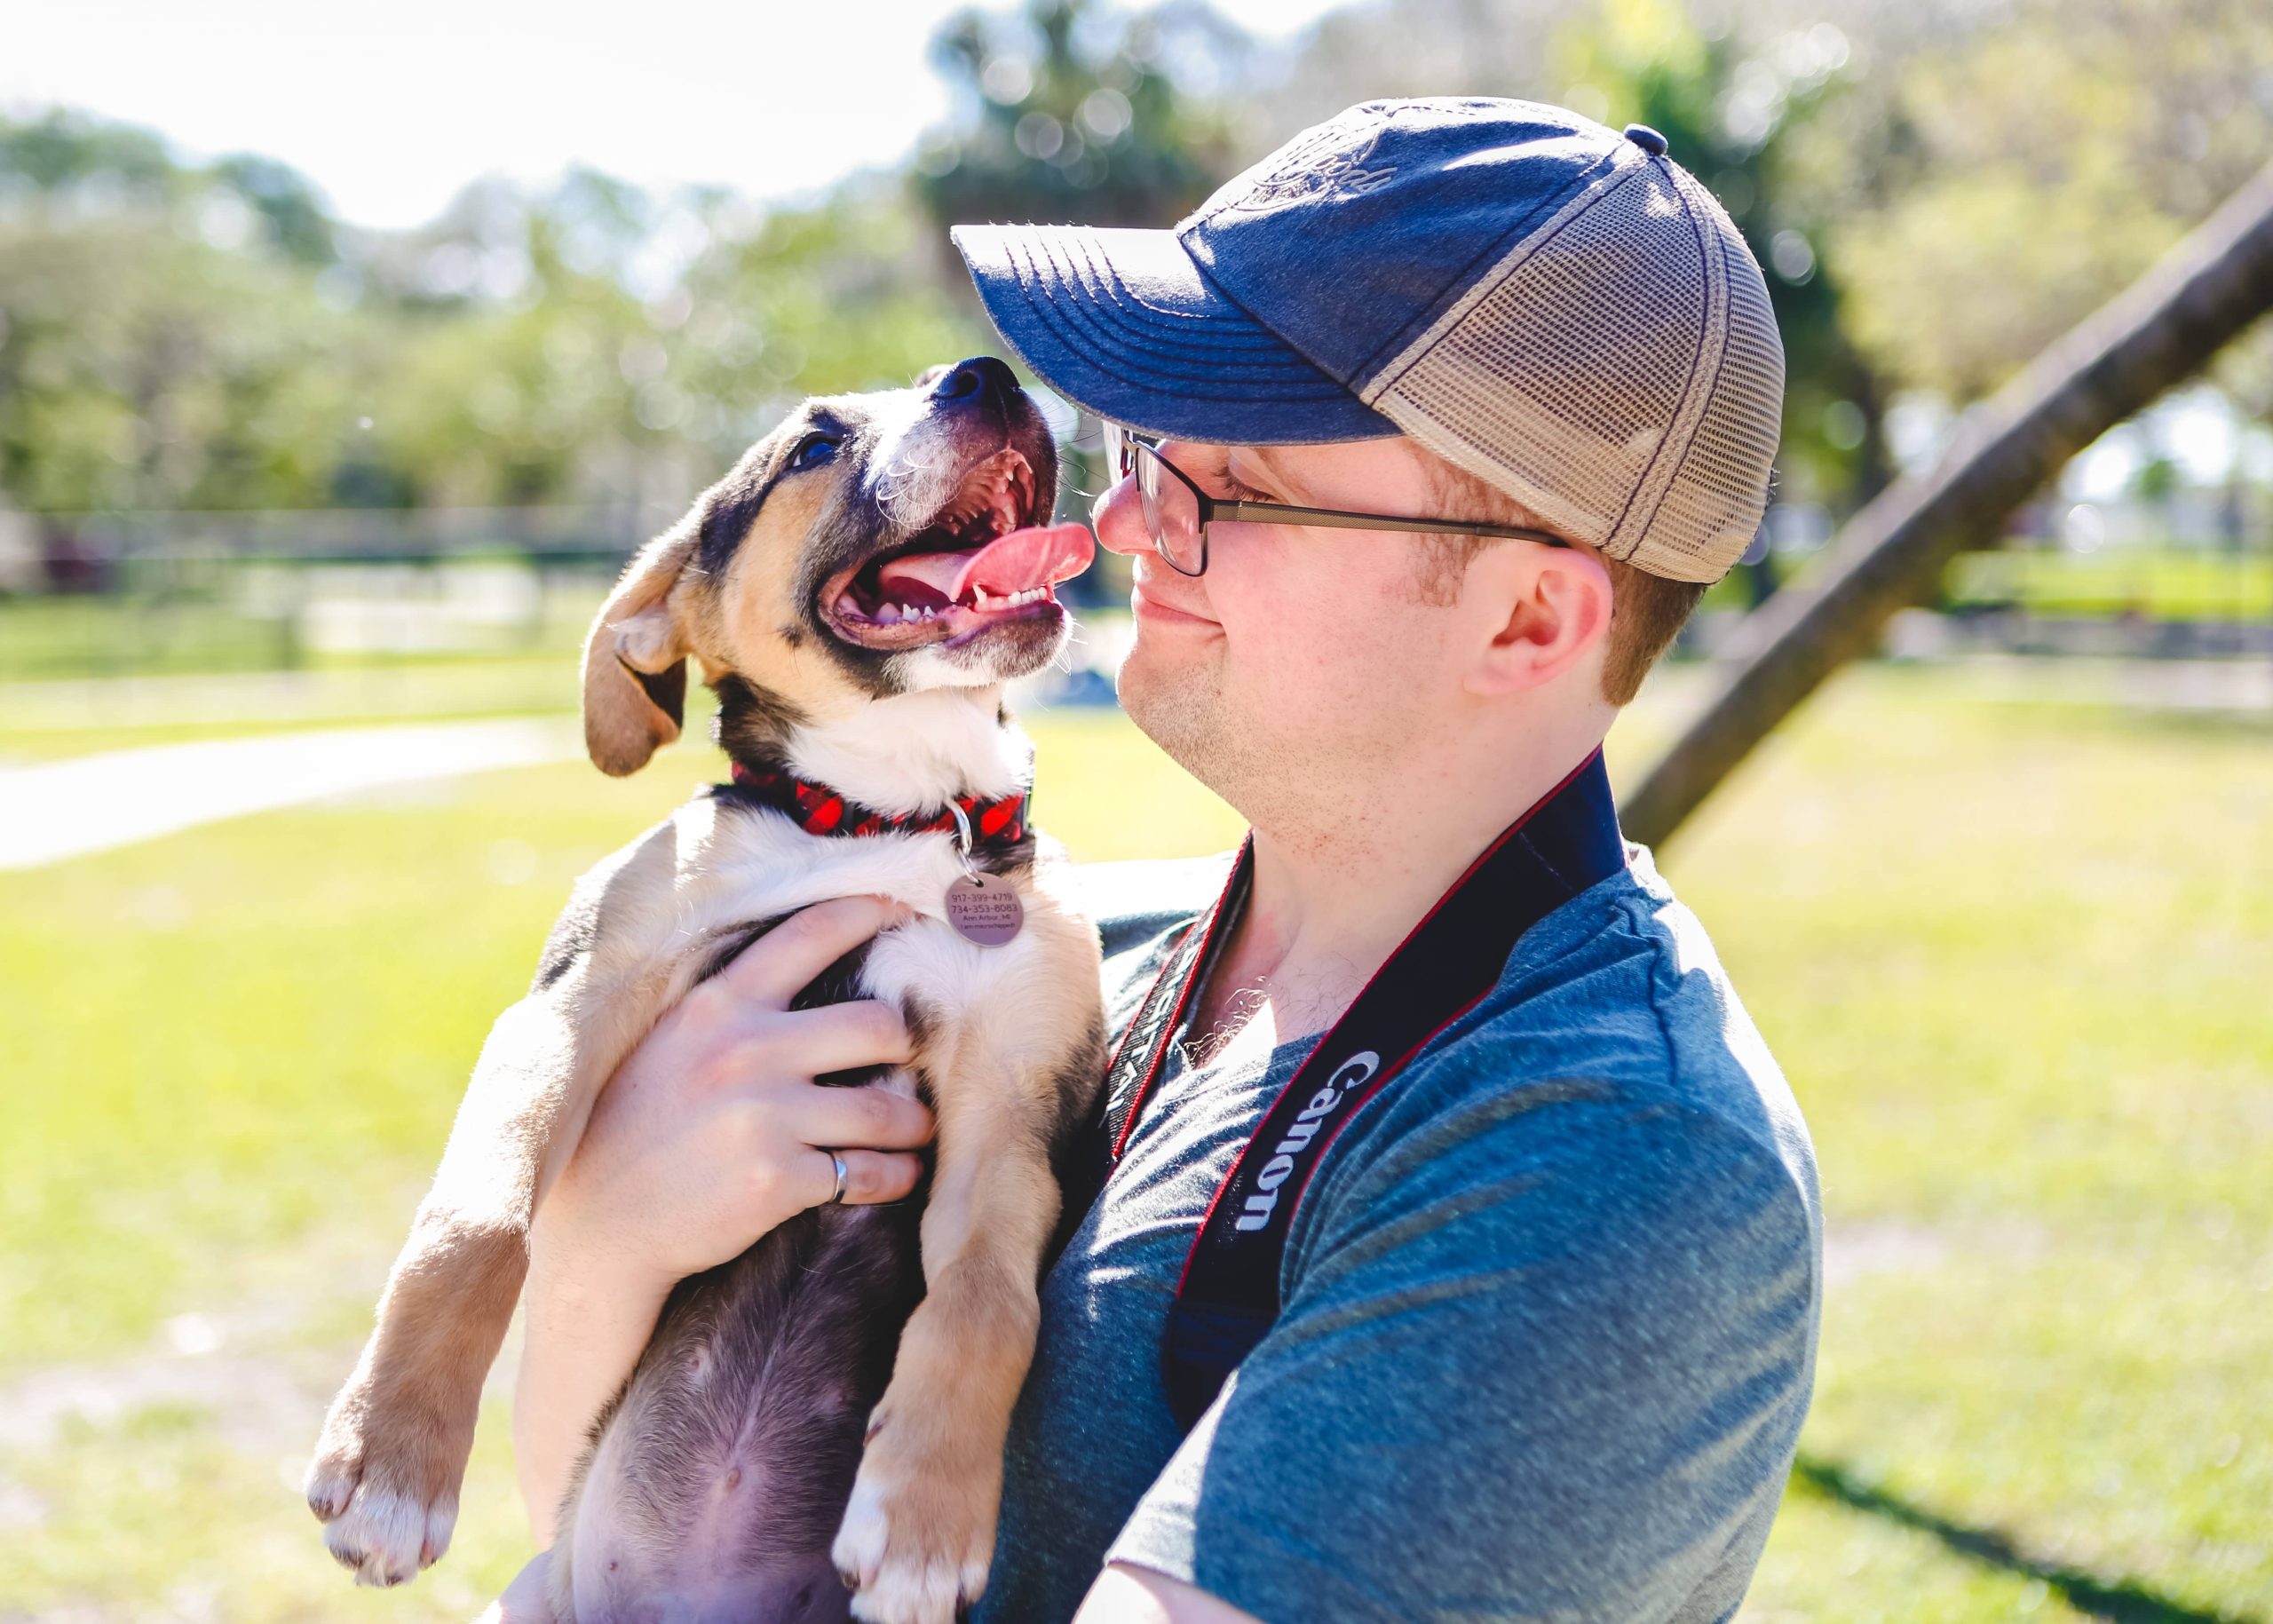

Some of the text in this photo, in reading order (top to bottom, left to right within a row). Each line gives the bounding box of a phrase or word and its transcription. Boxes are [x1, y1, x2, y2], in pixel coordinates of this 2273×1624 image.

[952, 893, 1012, 902] 917-399-4719
[952, 904, 1018, 913] 734-353-8083
[1236, 1051, 1380, 1231] Canon
